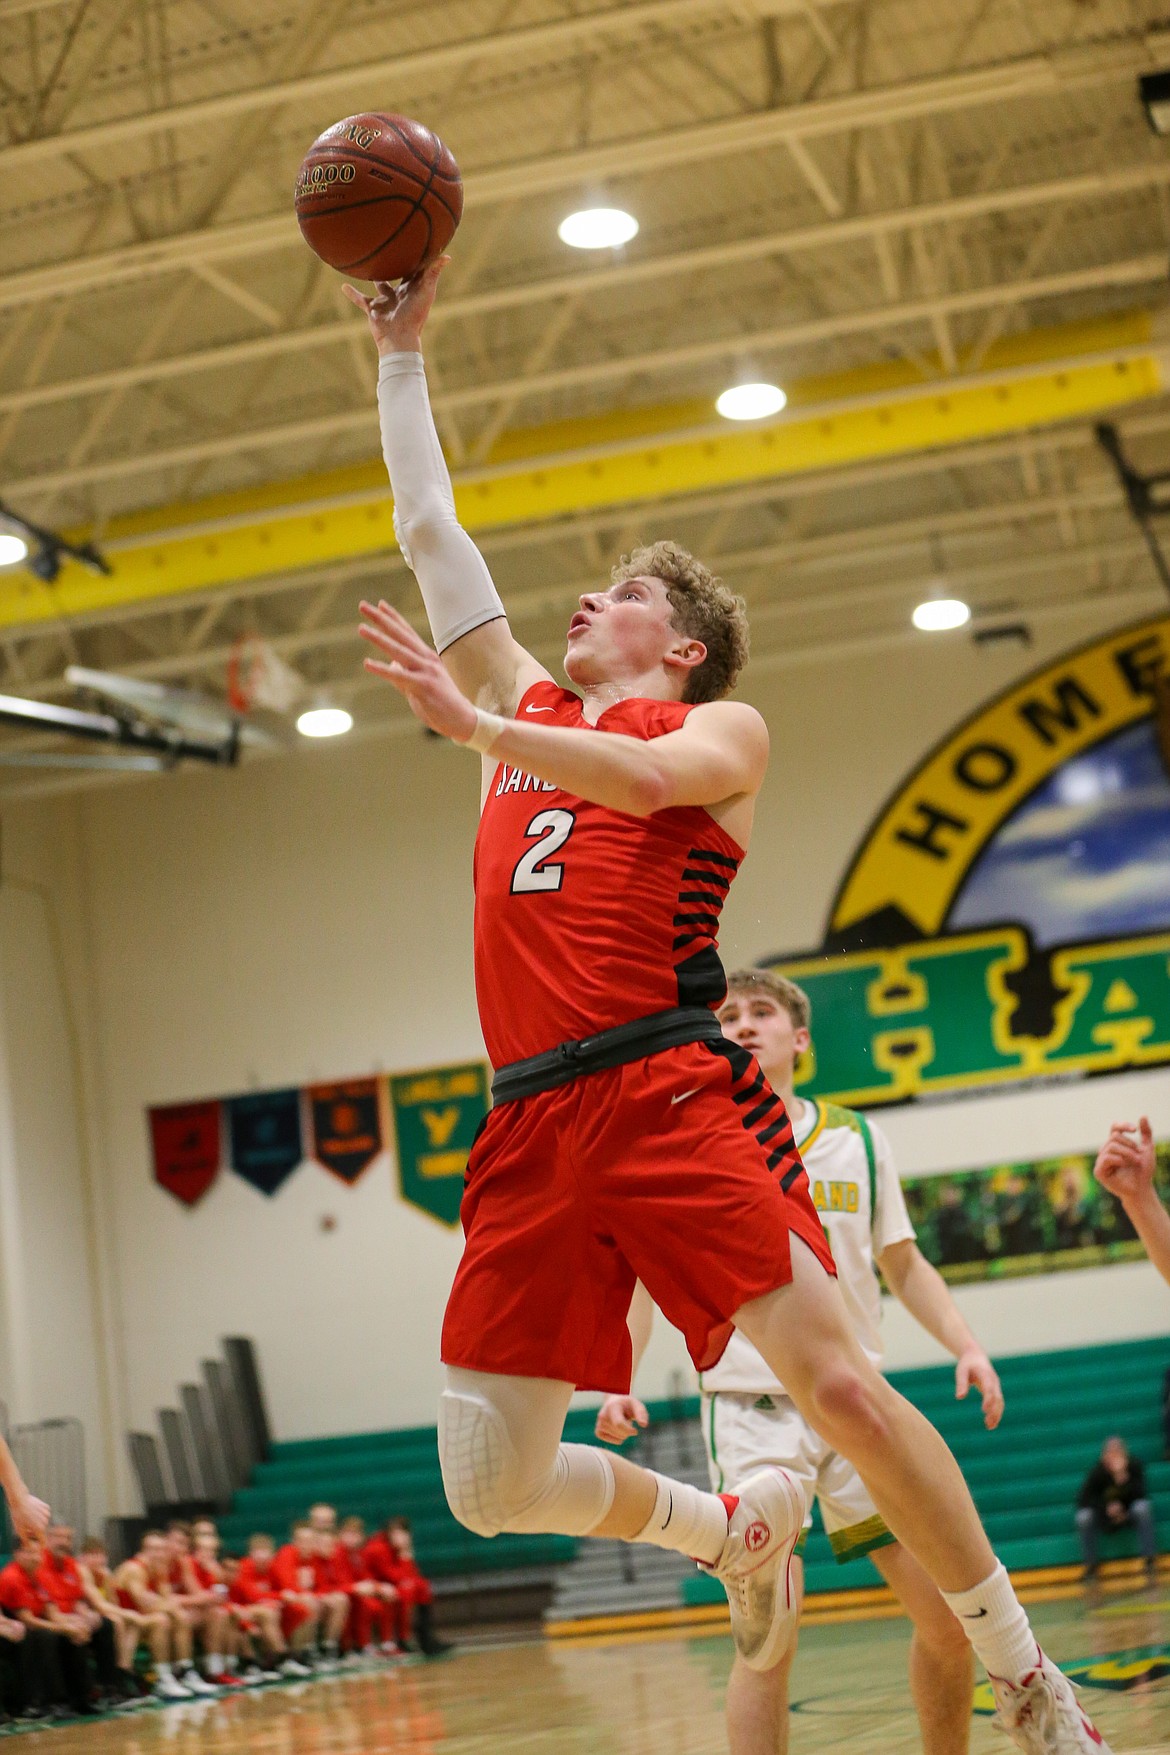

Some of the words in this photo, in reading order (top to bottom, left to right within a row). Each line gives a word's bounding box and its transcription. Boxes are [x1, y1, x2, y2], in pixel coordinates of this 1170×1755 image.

[894, 633, 1166, 861] HOME
[509, 807, 577, 896] 2
[813, 1180, 859, 1214] AND
